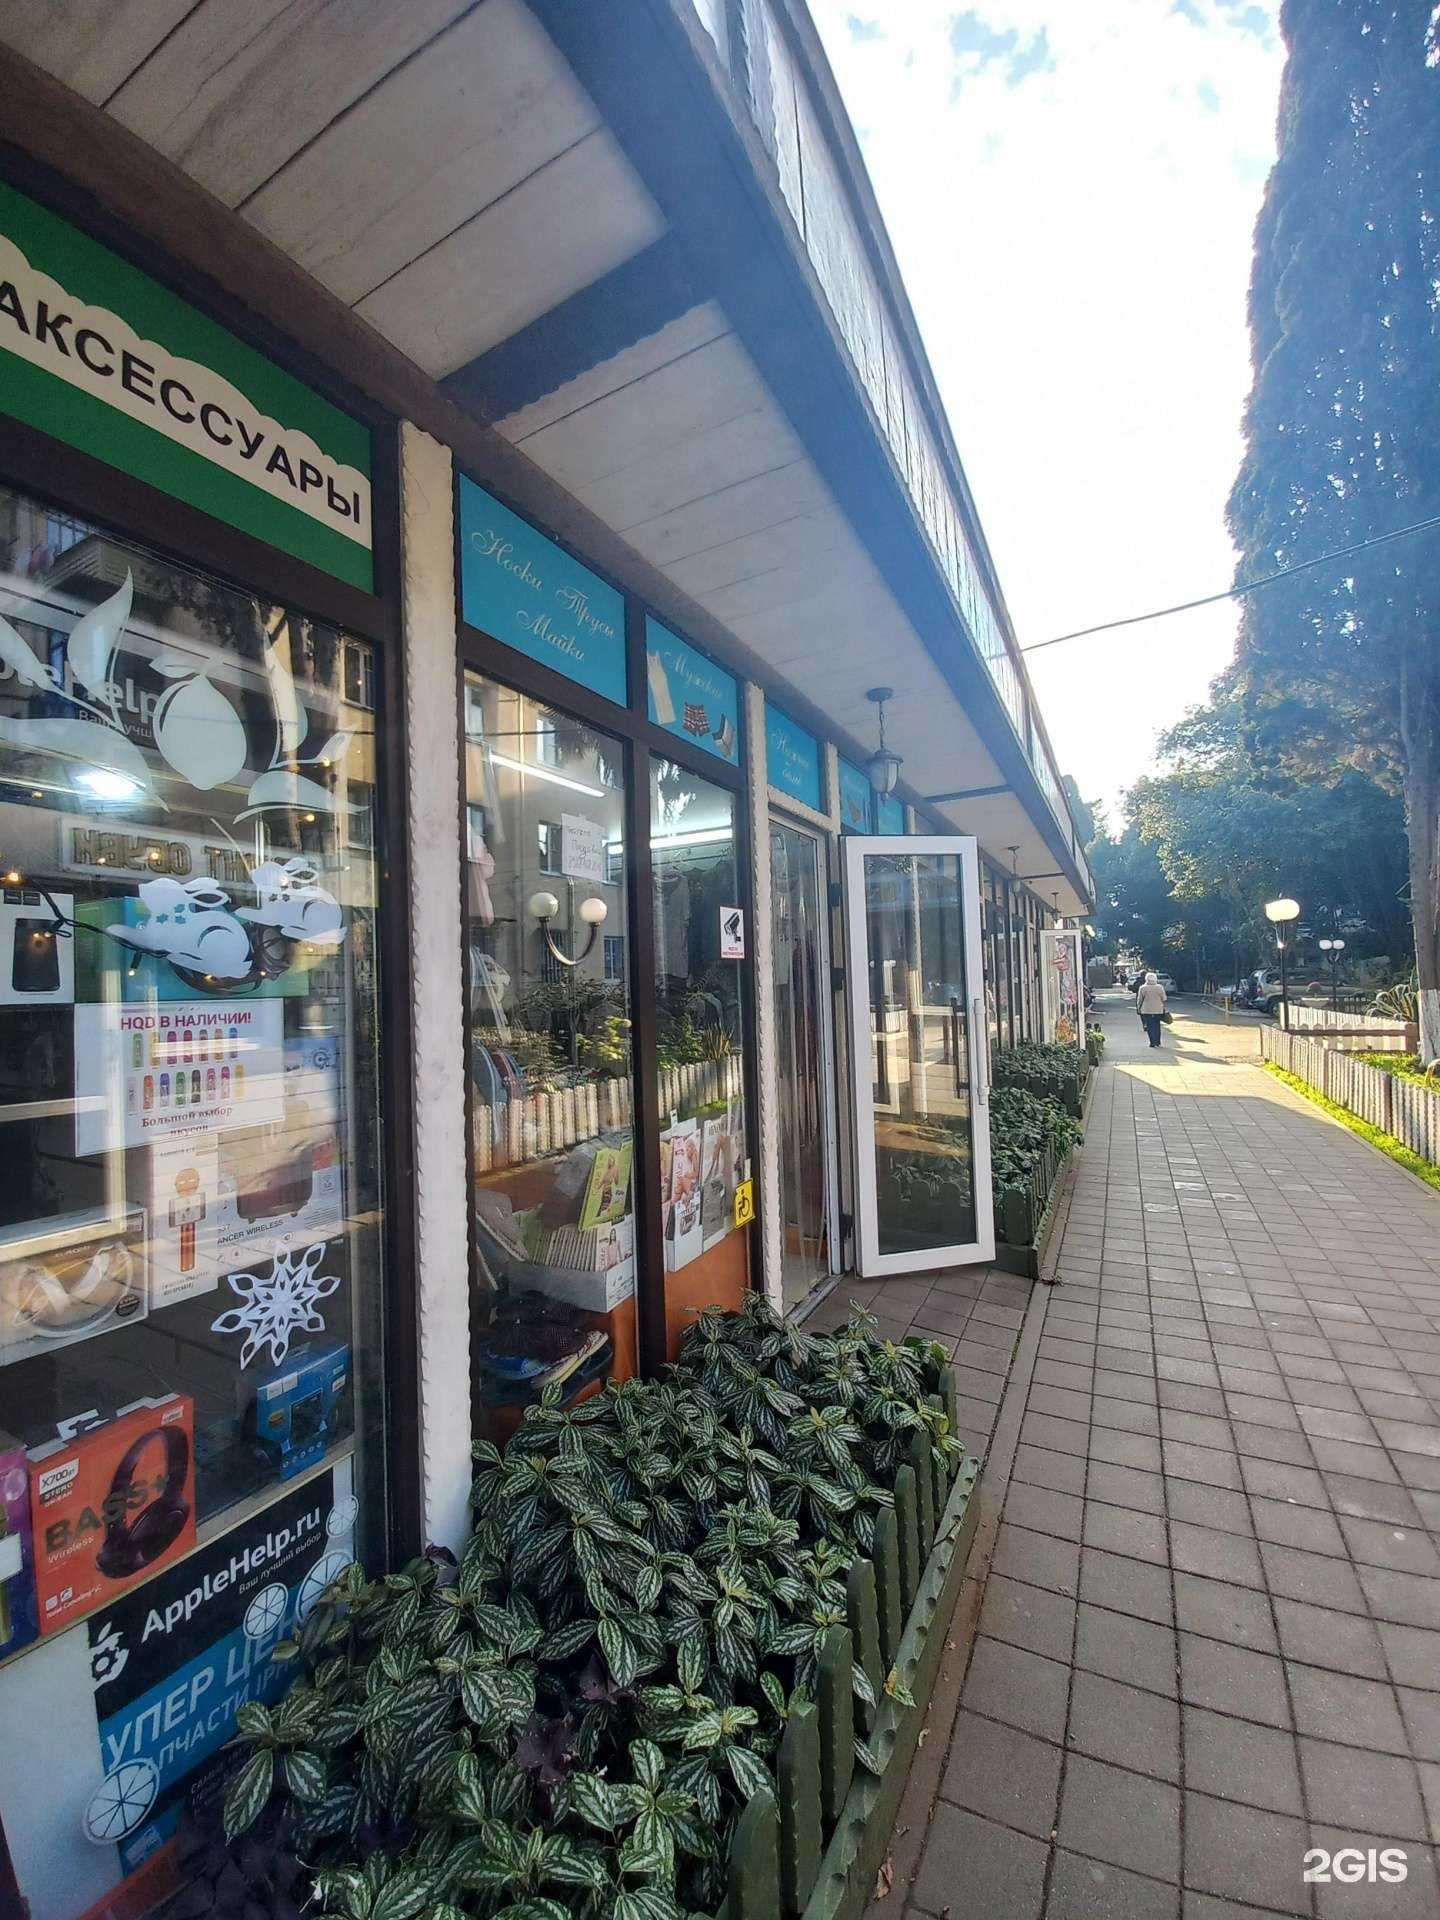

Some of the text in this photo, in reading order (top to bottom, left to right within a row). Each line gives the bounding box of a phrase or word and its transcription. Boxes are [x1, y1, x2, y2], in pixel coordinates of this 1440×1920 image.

[0, 281, 360, 524] АКСЕССУАРЫ
[471, 528, 544, 592] Носки
[515, 609, 586, 662] Майки
[120, 1011, 252, 1031] HQD В НАЛИЧИИ!
[217, 1231, 245, 1245] ANCER
[245, 1219, 285, 1237] WIRELESS
[48, 1535, 94, 1563] Wireless
[141, 1506, 321, 1644] AppleHelp.ru
[238, 1531, 322, 1595] Ваш лучший выбор
[106, 1616, 294, 1772] УПЕР ЦЕН
[159, 1683, 250, 1771] ПЧАСТИ
